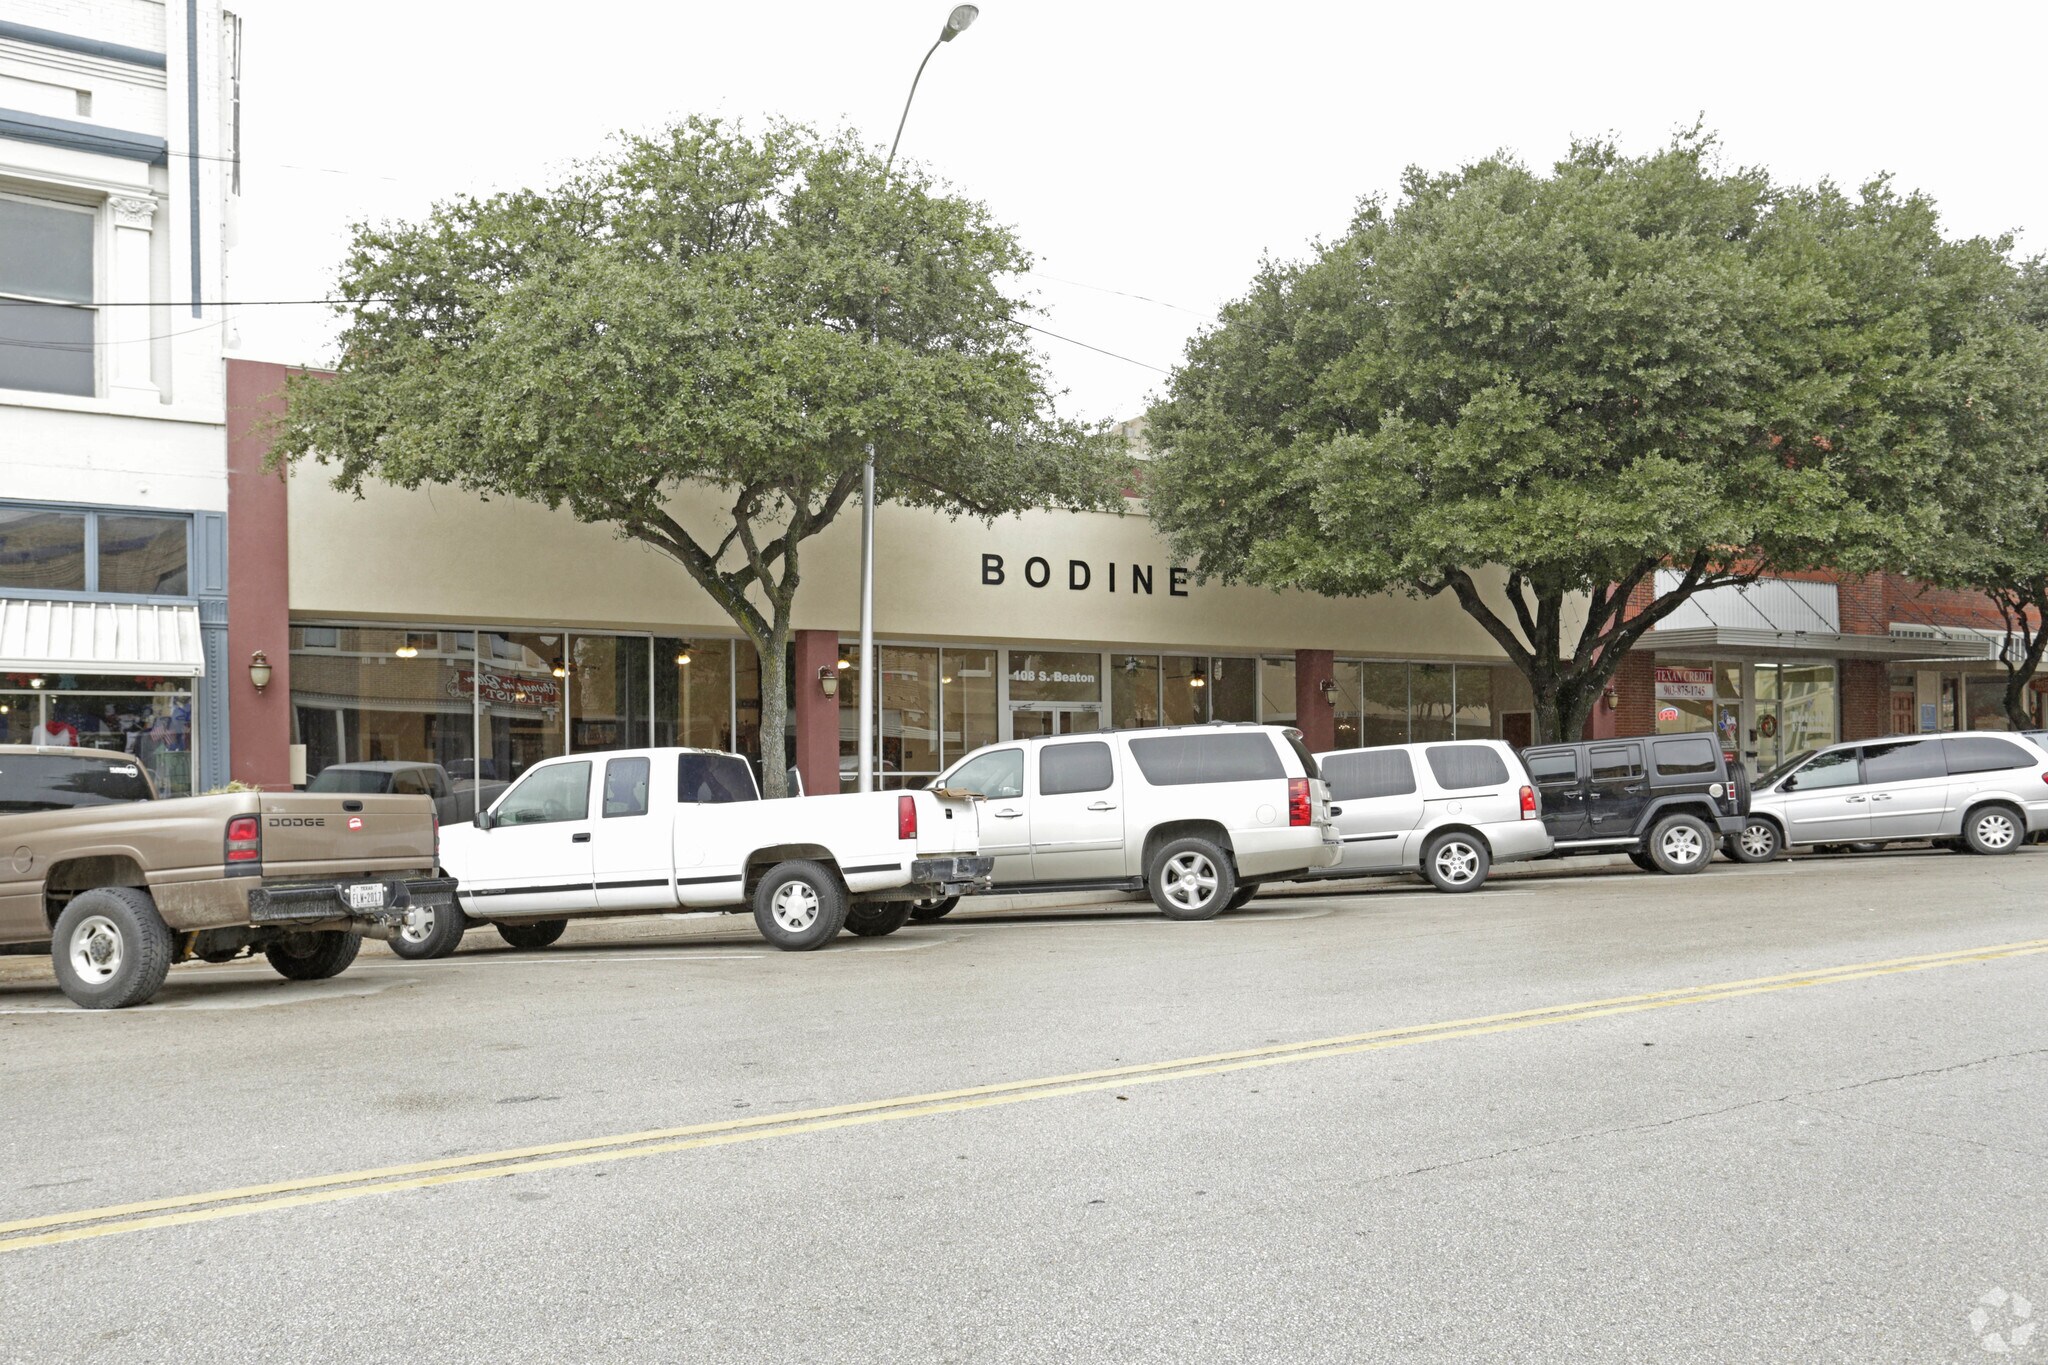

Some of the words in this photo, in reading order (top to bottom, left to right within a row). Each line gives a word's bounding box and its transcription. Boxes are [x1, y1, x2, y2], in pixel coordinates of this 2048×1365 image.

[981, 553, 1189, 597] BODINE
[1013, 670, 1036, 682] 108
[1038, 671, 1051, 682] S.
[1053, 671, 1095, 683] Beaton
[1656, 669, 1683, 682] TEXAN
[1684, 670, 1712, 683] CREDIT
[1658, 709, 1678, 721] OPEN
[269, 818, 325, 827] DODGE
